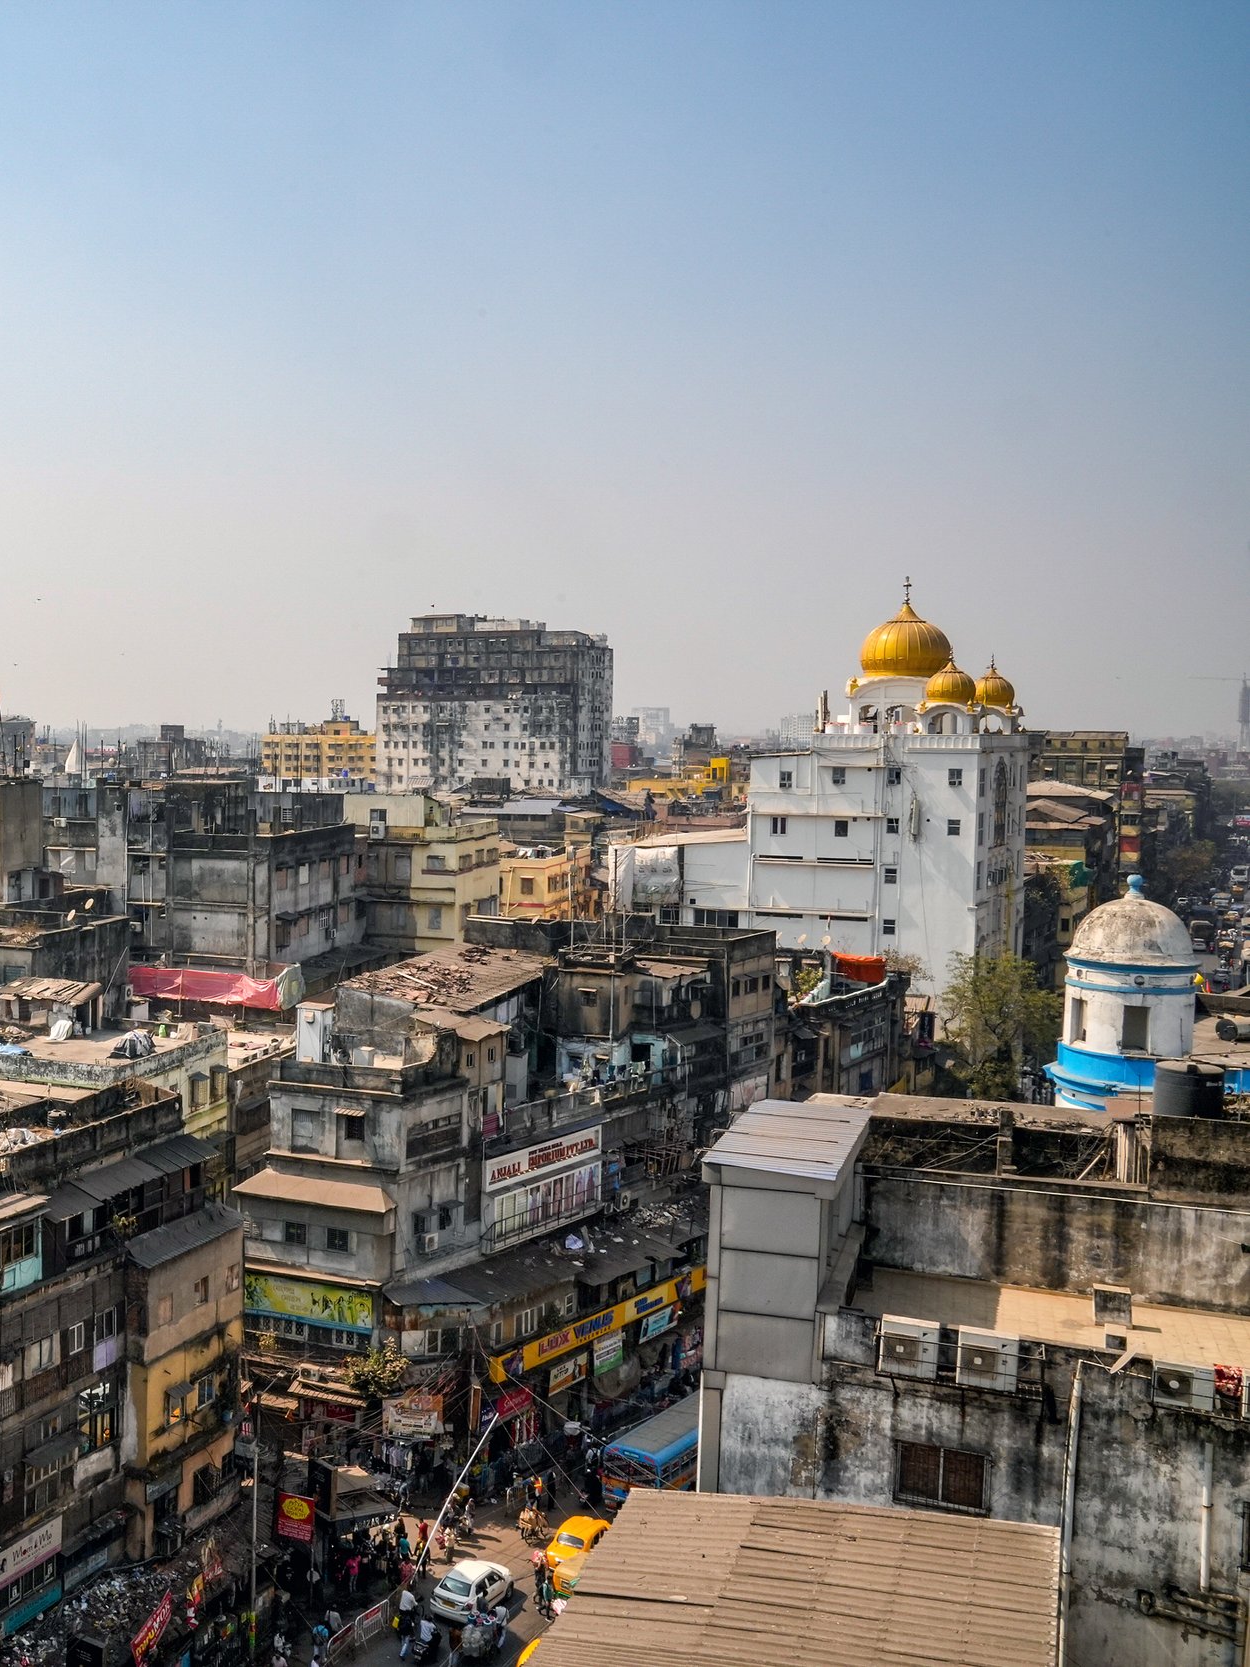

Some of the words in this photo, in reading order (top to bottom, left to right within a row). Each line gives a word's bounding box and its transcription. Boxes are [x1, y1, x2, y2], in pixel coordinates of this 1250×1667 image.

[528, 1146, 566, 1168] EMPORIUM
[490, 1162, 521, 1180] ANJALI
[539, 1331, 571, 1357] LUX
[574, 1310, 614, 1339] VENUS
